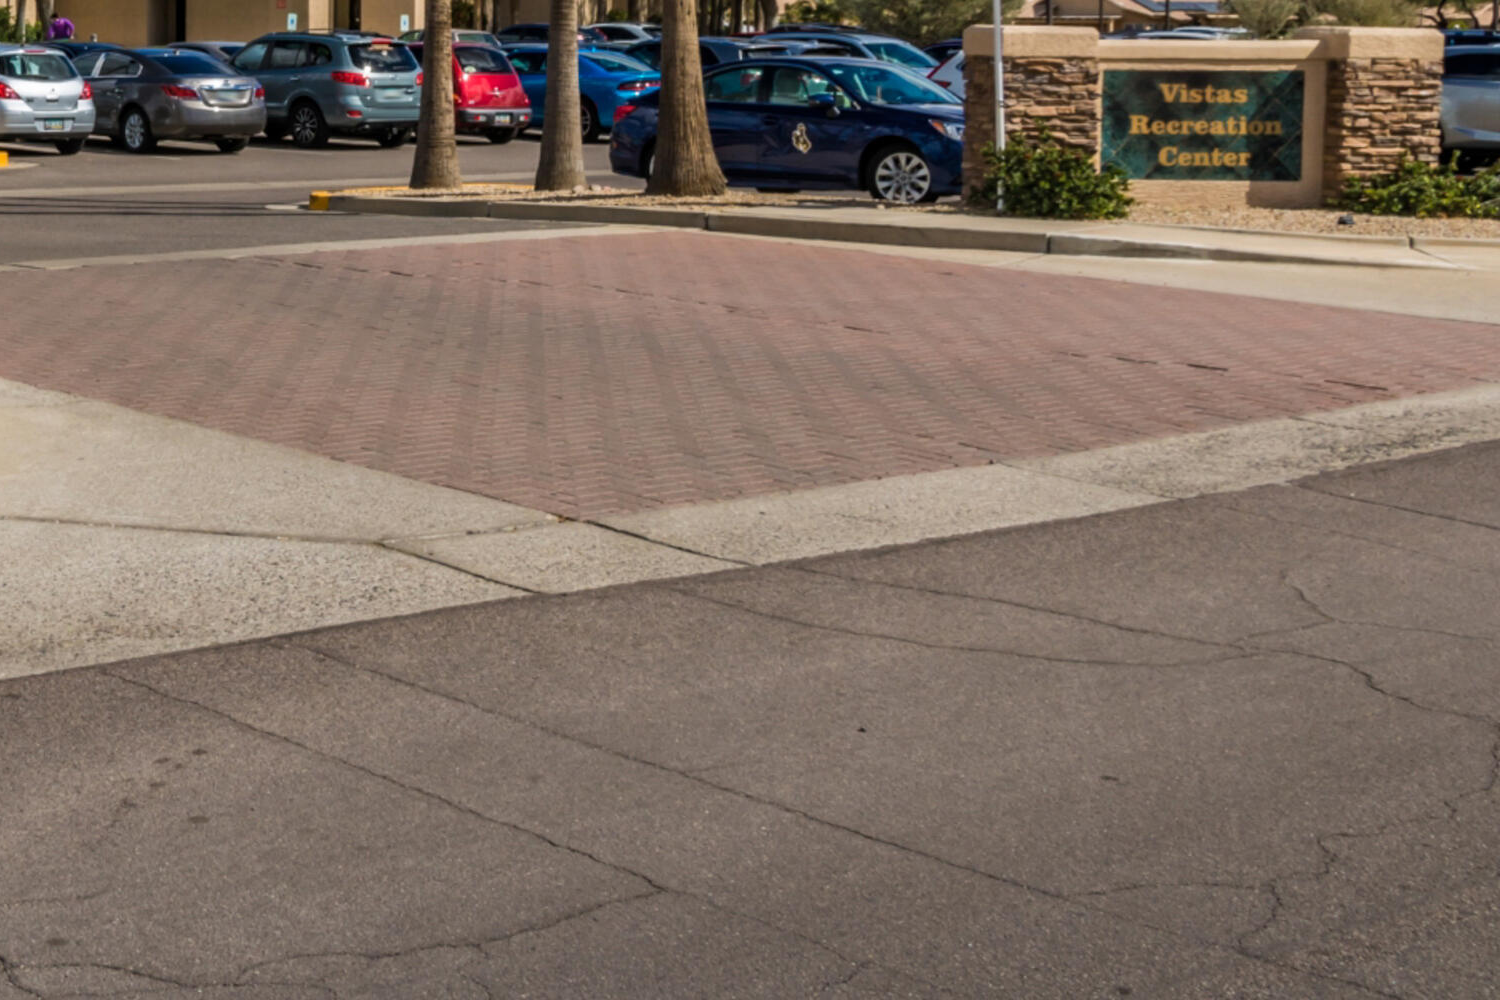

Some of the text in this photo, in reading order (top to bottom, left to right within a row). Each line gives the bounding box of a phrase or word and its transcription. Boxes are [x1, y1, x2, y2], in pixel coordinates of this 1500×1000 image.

[1159, 83, 1249, 104] Vistas
[1129, 115, 1283, 135] Recreation
[1158, 146, 1252, 167] Center
